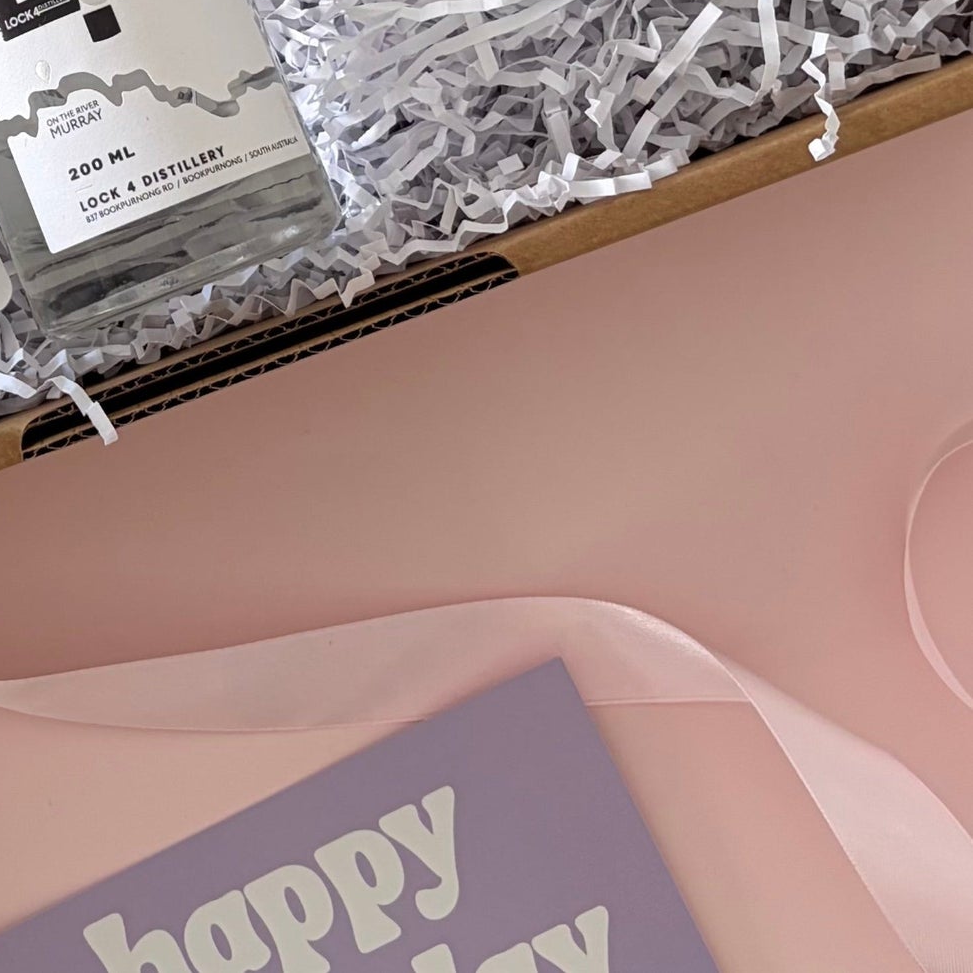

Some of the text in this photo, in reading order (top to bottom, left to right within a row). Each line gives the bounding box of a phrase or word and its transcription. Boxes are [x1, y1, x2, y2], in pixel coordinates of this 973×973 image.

[46, 99, 100, 127] ON THE RIVER
[49, 108, 102, 140] MURRAY
[68, 146, 136, 181] 200 ML
[79, 145, 225, 212] LOCK 4 DISTILLERY
[98, 187, 162, 219] BOOKPURNONG
[162, 182, 174, 193] RD
[182, 155, 243, 184] BOOKPURNONG
[248, 145, 272, 160] SOUTH
[82, 785, 460, 973] happy
